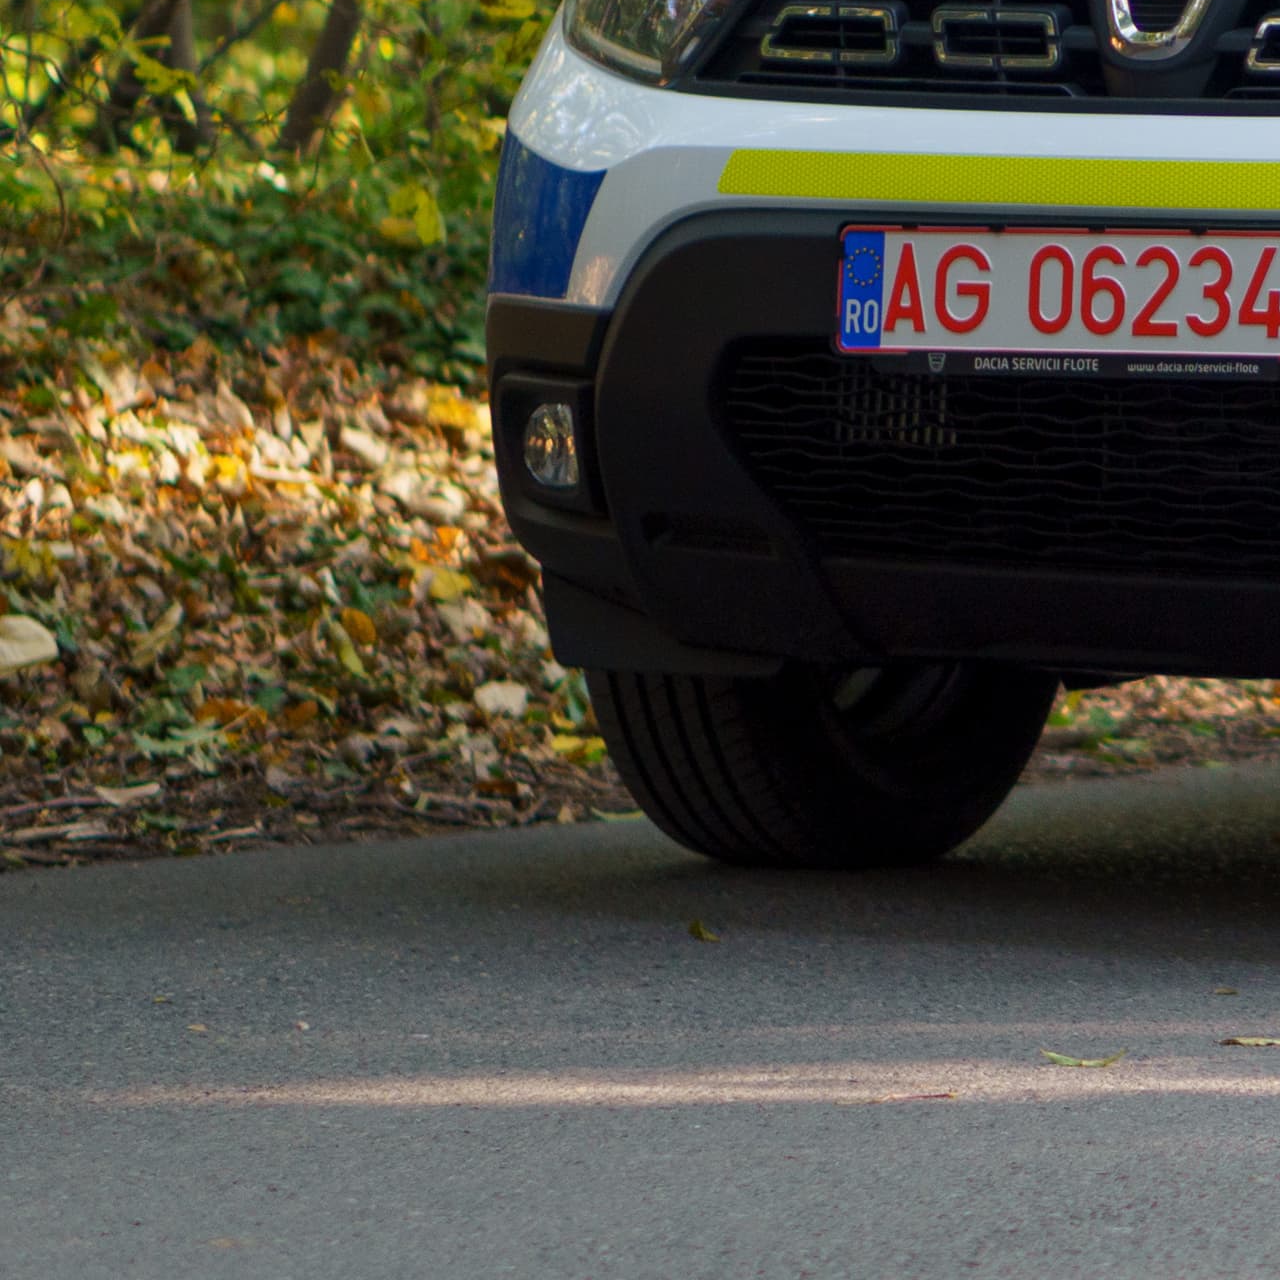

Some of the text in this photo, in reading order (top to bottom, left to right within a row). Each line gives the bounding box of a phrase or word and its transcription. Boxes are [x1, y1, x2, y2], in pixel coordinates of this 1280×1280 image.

[883, 242, 993, 334] AG
[845, 298, 879, 335] RO
[974, 356, 1099, 372] DACIA SERVICII FLOTE
[1127, 361, 1260, 374] www.dacia.ro/servicii-flote
